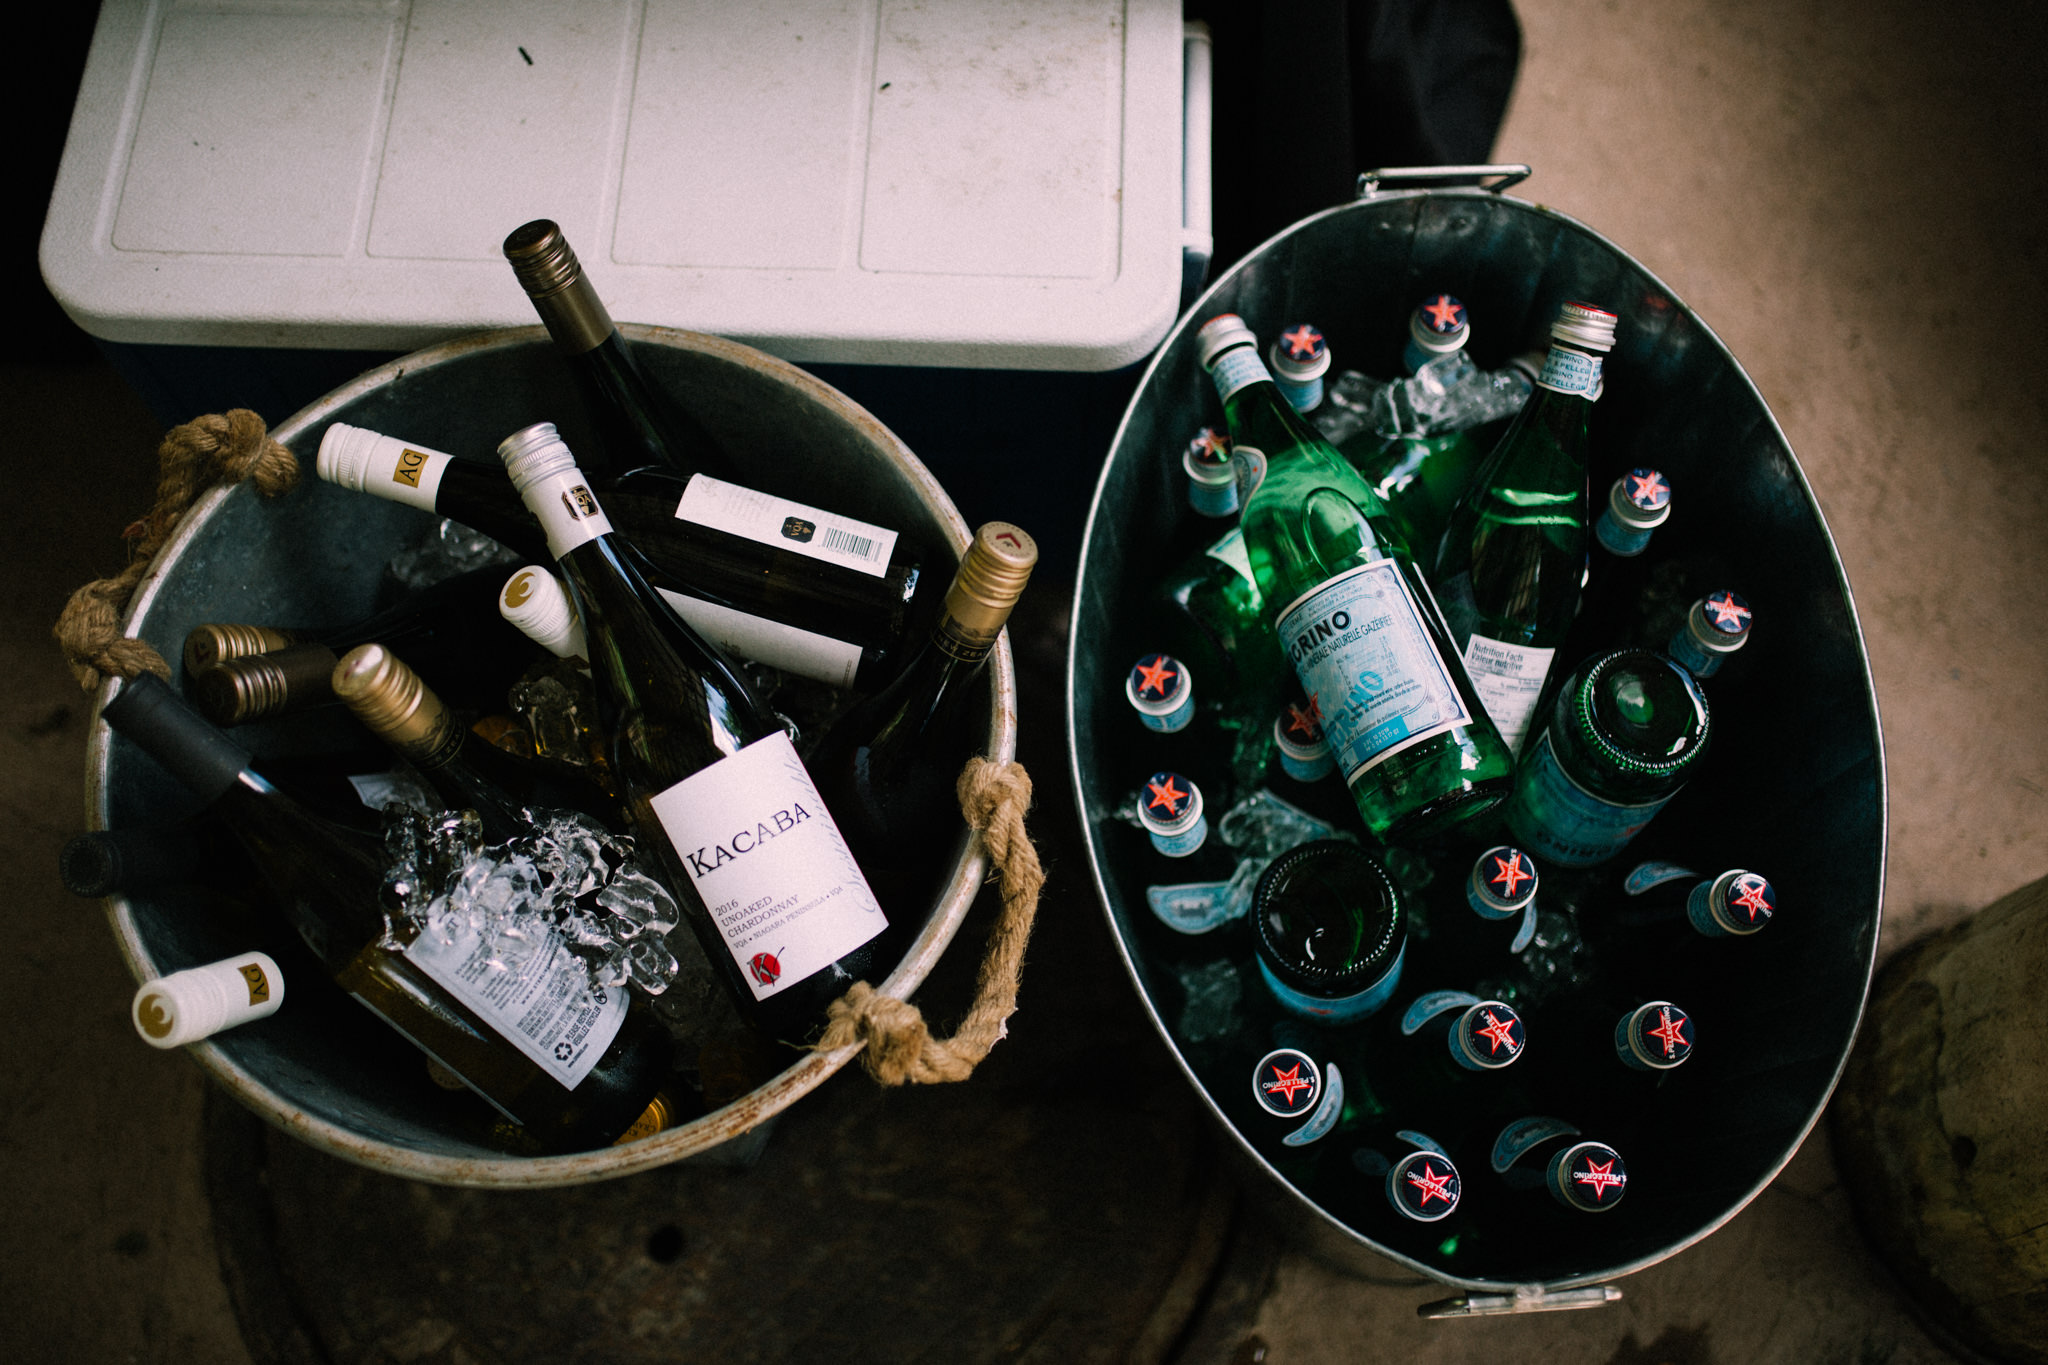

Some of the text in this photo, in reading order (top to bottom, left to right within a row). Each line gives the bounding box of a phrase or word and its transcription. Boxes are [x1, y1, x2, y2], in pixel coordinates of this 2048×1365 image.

[400, 454, 426, 483] AG
[1286, 610, 1352, 664] GRINO
[686, 802, 812, 879] KACABA
[1504, 848, 1518, 897] S.PELLEGRINO
[715, 899, 739, 917] 2016
[721, 895, 772, 927] UNOAKED
[727, 894, 799, 938] CHARDONNAY
[733, 937, 748, 950] VQA
[753, 918, 785, 939] NIAGARA
[249, 967, 267, 997] AG
[564, 1021, 581, 1041] PLEASE
[571, 1024, 590, 1047] VEUILLEZ
[584, 1005, 602, 1027] RECYCLER
[1480, 1010, 1516, 1055] S.PELLEGRINO
[1664, 1006, 1676, 1060] S.PELLEGRINO
[1262, 1075, 1315, 1089] S.PELLEGRINO
[1406, 1171, 1457, 1201] S.PELLEGRINO
[1573, 1171, 1627, 1183] S.PELLEGRINO
